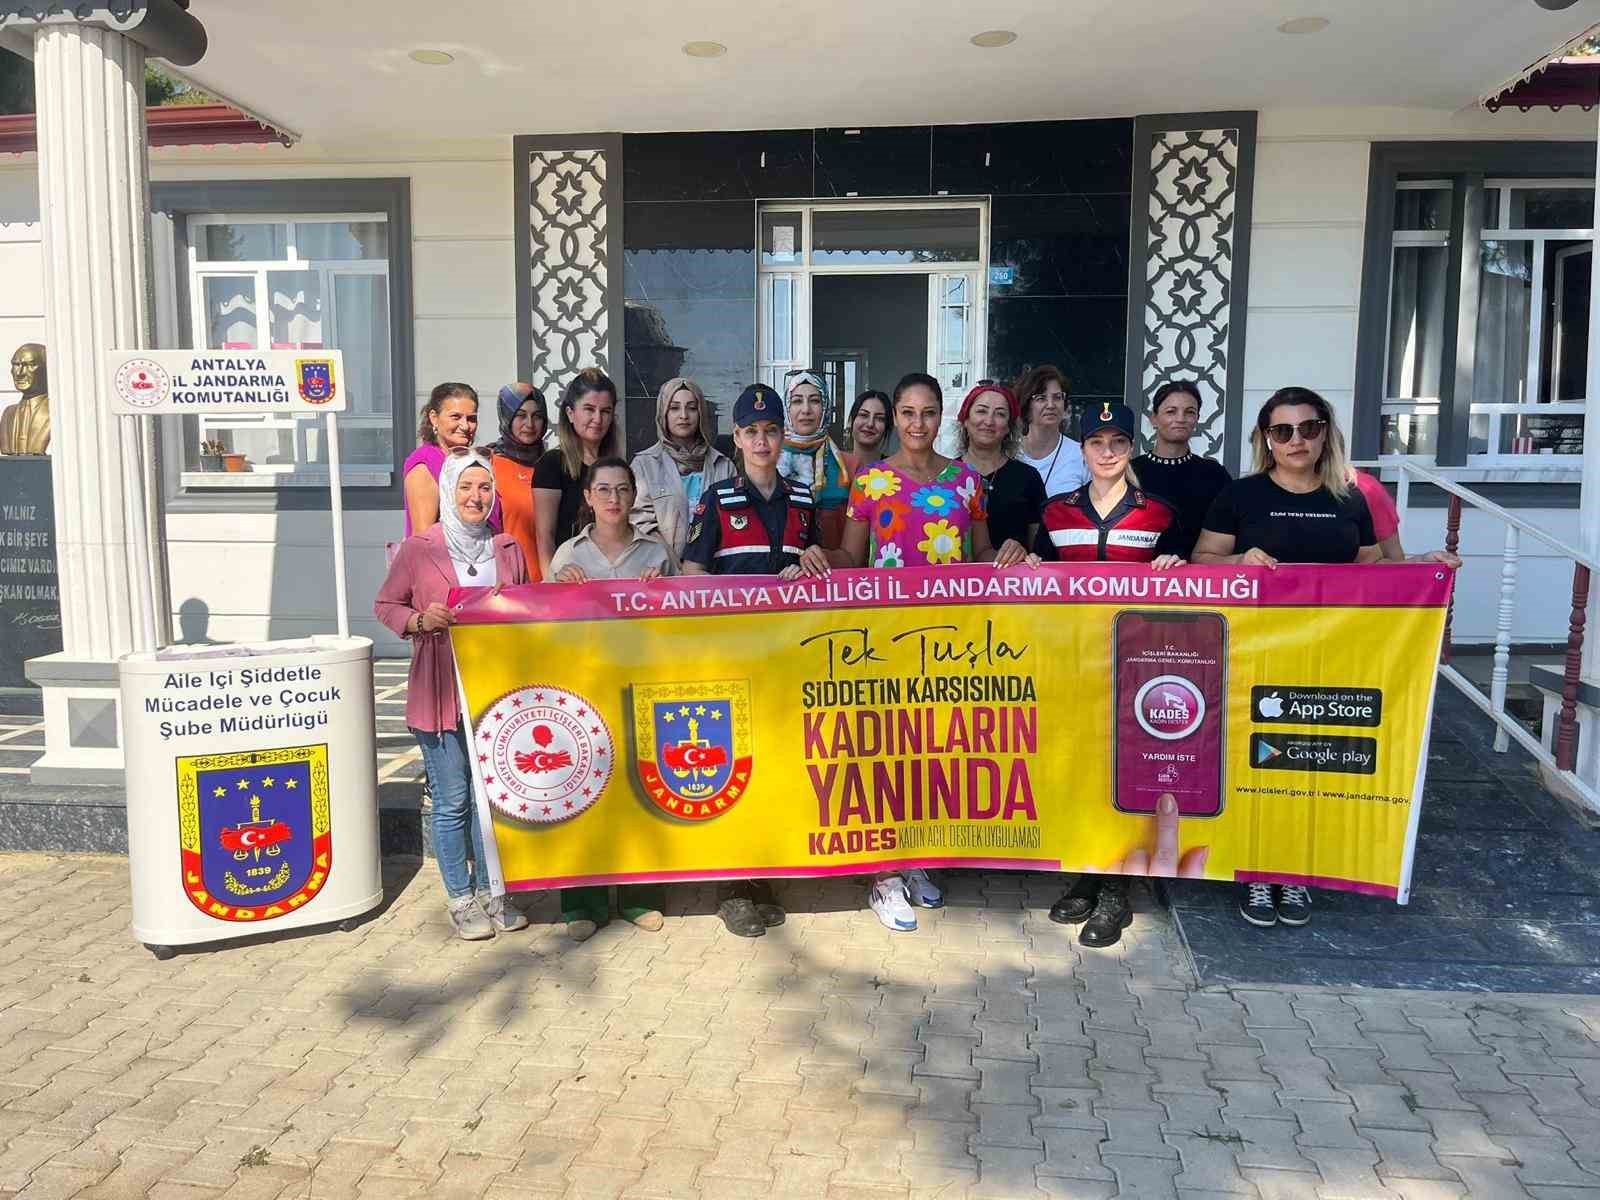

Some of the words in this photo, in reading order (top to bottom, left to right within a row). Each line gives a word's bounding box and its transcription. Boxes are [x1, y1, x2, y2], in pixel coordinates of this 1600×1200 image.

[191, 359, 267, 371] ANTALYA
[193, 375, 285, 388] JANDARMA
[172, 388, 290, 404] KOMUTANLIĞI
[611, 591, 655, 612] T.C.
[661, 587, 773, 610] ANTALYA
[778, 577, 881, 604] VALİLİĞİ
[888, 576, 910, 600] İL
[916, 576, 1062, 599] JANDARMA
[1069, 574, 1259, 600] KOMUTANLIĞI
[800, 627, 889, 680] Tek
[891, 619, 1029, 677] Tuşla
[164, 673, 203, 689] Aile
[240, 666, 322, 688] Şiddetle
[145, 694, 243, 714] Mücadele
[250, 697, 273, 707] ve
[279, 686, 342, 708] Çocuk
[907, 675, 1037, 705] KARŞISINDA
[1289, 691, 1339, 701] Download
[1341, 693, 1354, 701] on
[1356, 693, 1373, 702] the
[1150, 708, 1189, 720] KADES
[1289, 701, 1325, 719] App
[1327, 702, 1373, 718] Store
[160, 720, 212, 741] Şube
[803, 706, 1038, 760] KADINLARIN
[1142, 752, 1175, 761] YARDIM
[1287, 746, 1338, 765] Google
[1342, 750, 1372, 766] play
[646, 772, 747, 815] JANDARMA
[807, 758, 1038, 827] YANINDA
[809, 828, 897, 855] KADES
[950, 823, 983, 848] DESTEK
[246, 866, 272, 877] 1839
[186, 852, 328, 919] JANDARMA
